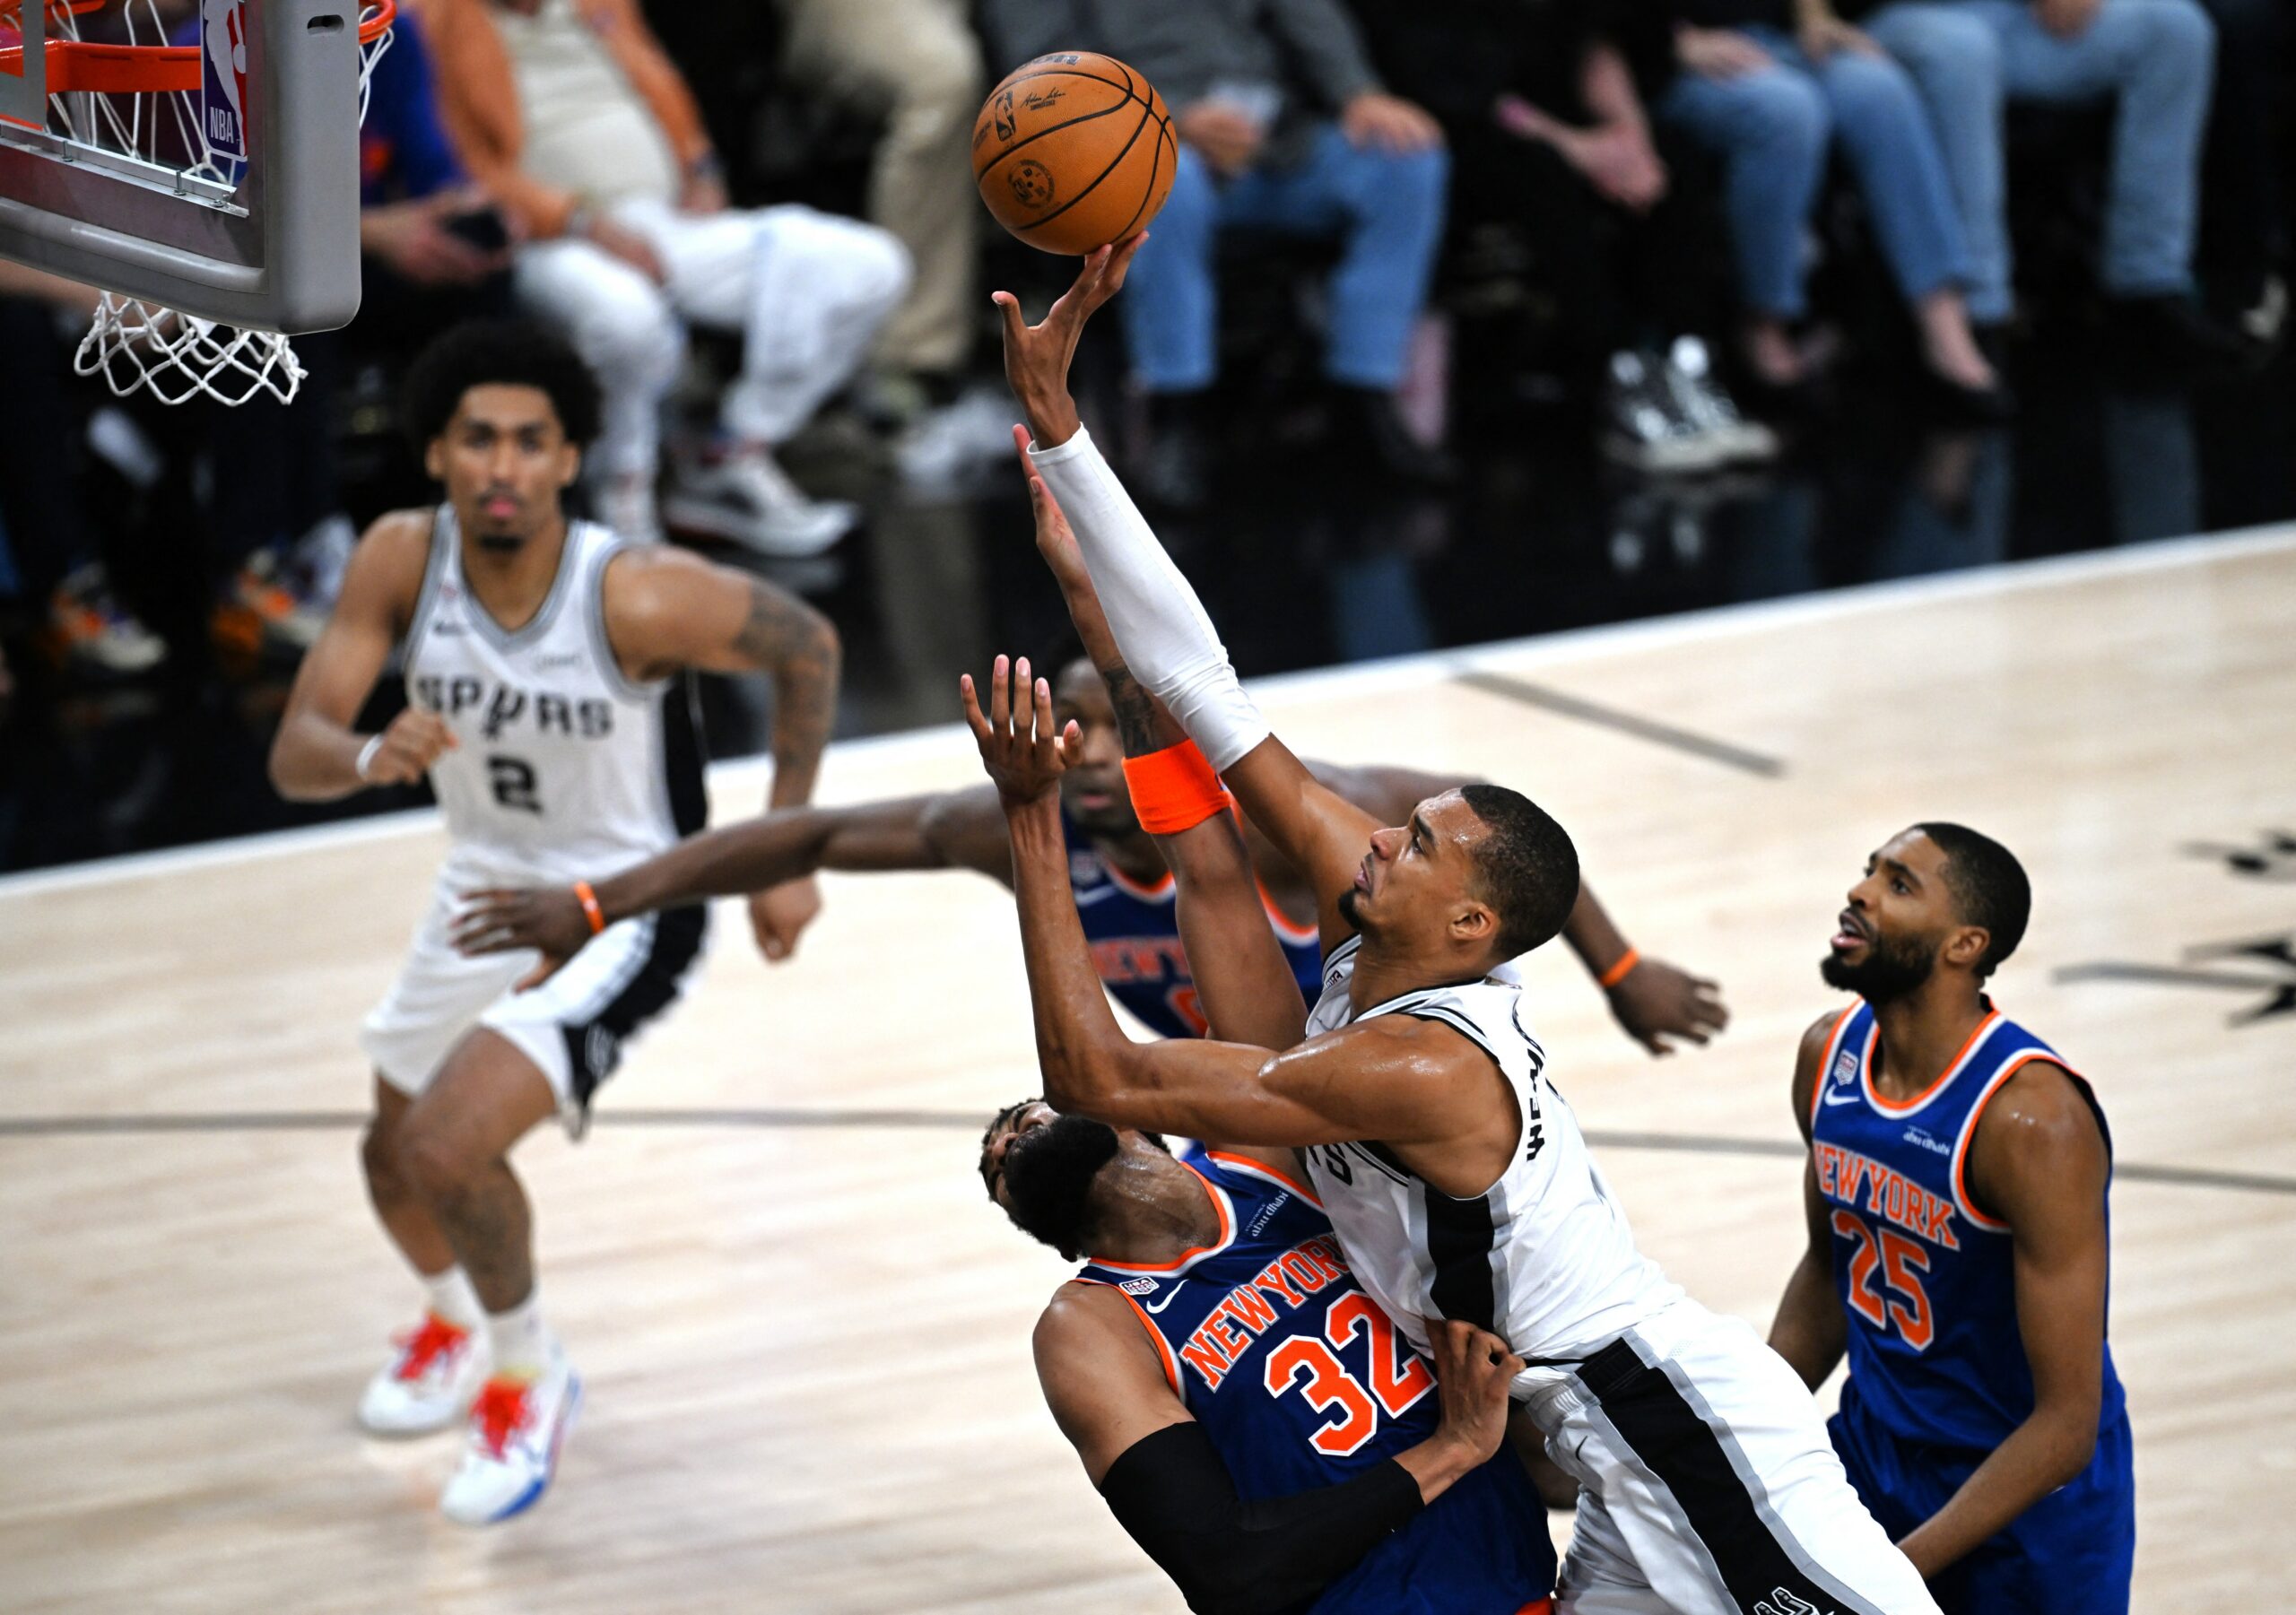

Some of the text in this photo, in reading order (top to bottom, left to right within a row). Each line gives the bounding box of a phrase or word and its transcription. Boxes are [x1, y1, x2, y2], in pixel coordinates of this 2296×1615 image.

[210, 106, 234, 144] NBA
[487, 754, 544, 814] 2
[1251, 1190, 1289, 1237] abu dhabi
[1866, 1159, 1961, 1252] YORK
[1831, 1208, 1935, 1352] 25
[1178, 1284, 1281, 1394] NEW
[1264, 1289, 1439, 1457] 32
